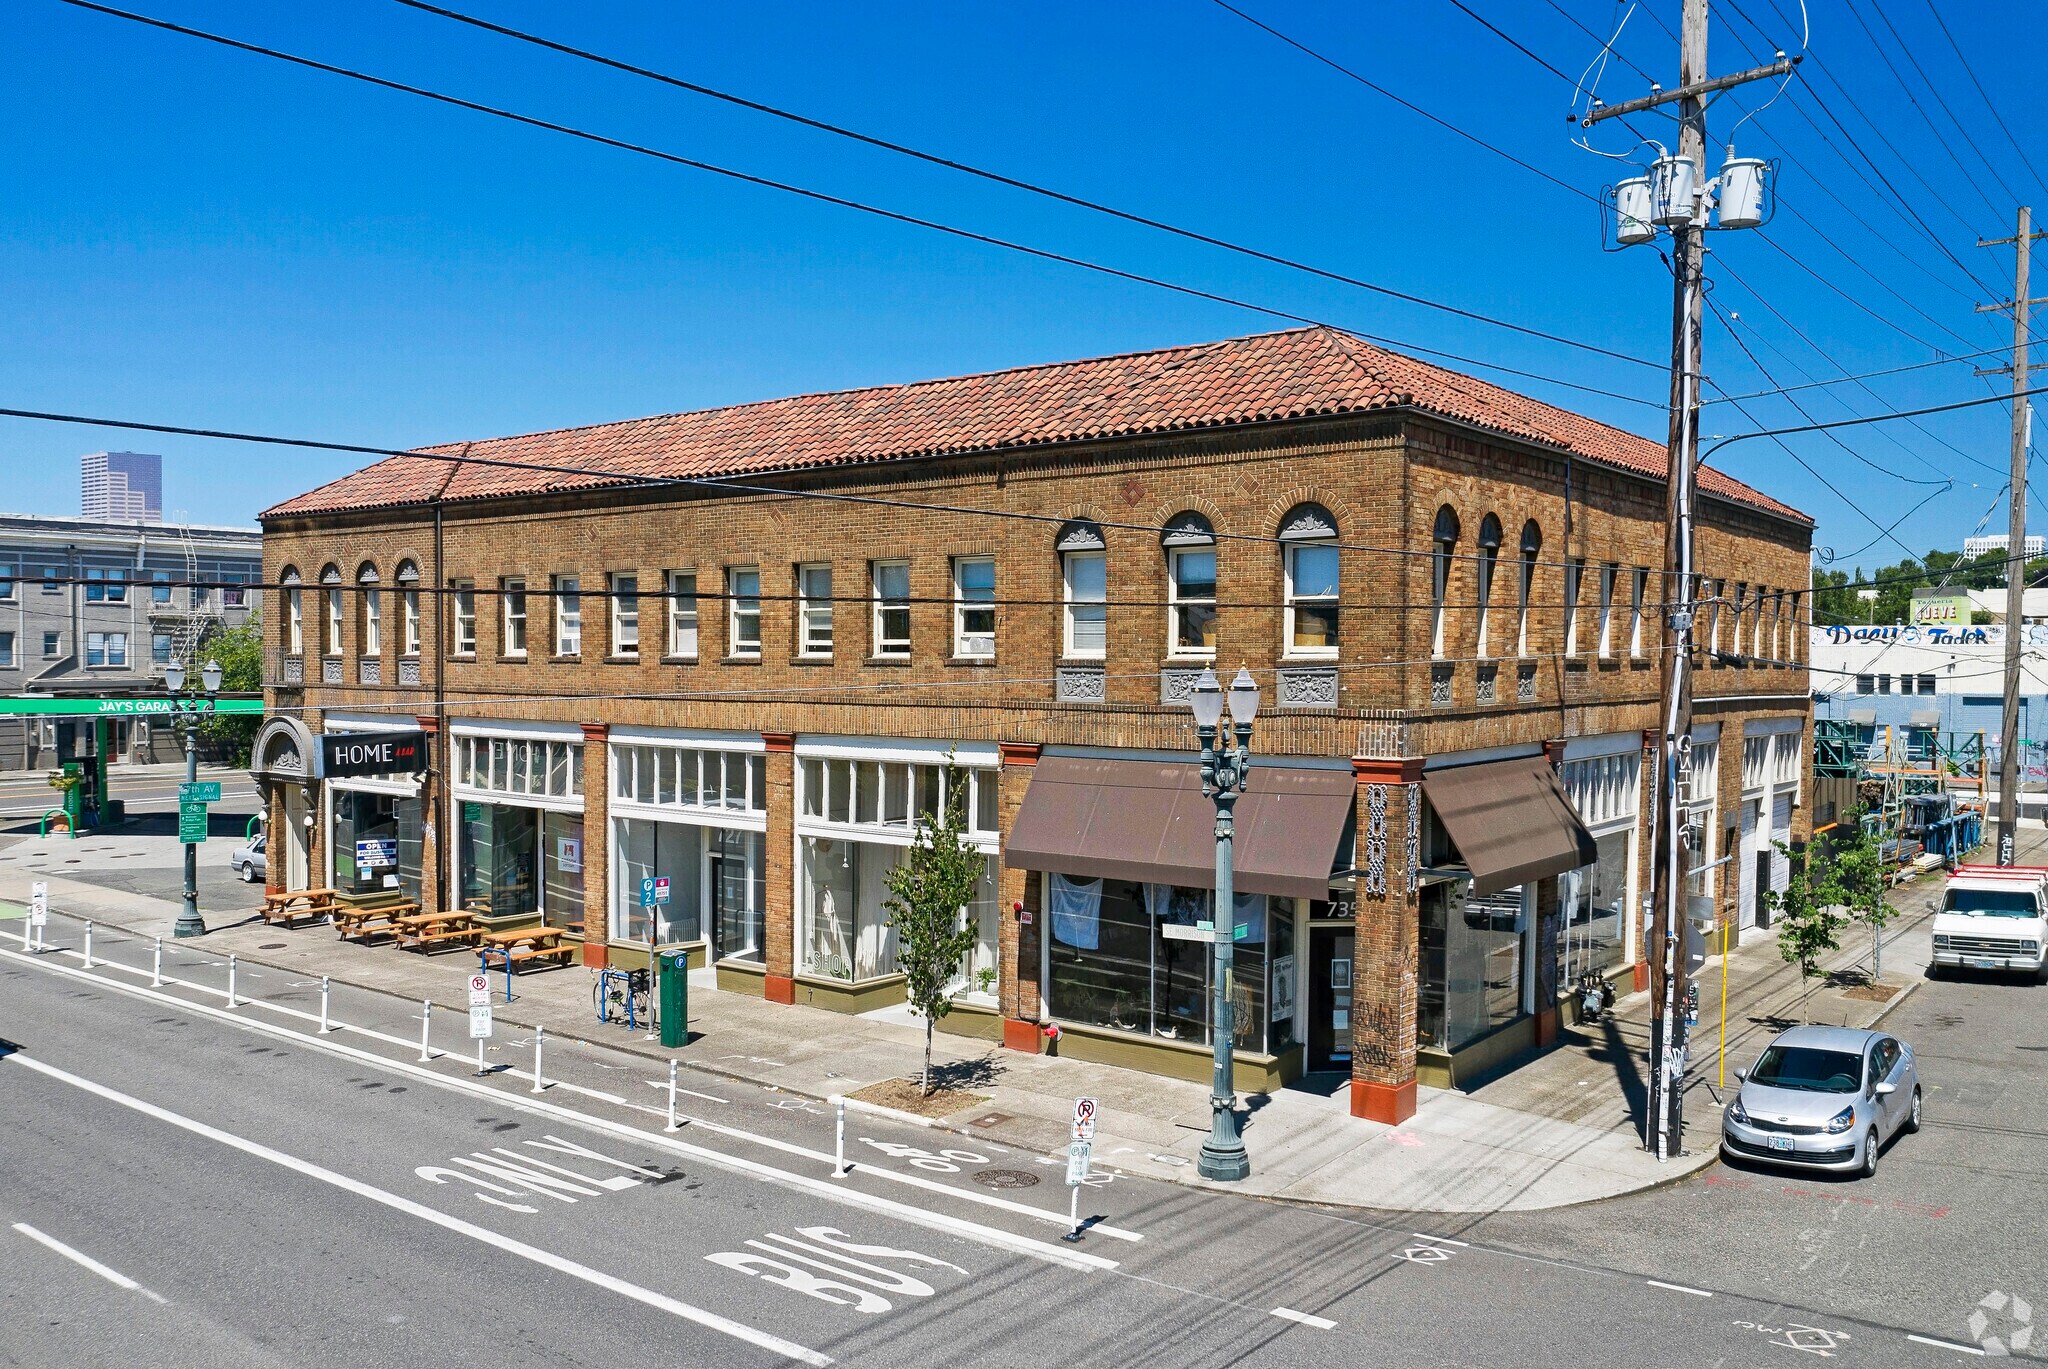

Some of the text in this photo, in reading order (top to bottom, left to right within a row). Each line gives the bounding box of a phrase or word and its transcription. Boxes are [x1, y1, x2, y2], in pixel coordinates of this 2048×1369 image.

[98, 701, 186, 712] JAY'S GARAE
[335, 743, 393, 765] HOME
[645, 892, 652, 902] 2
[703, 1225, 970, 1314] BUS
